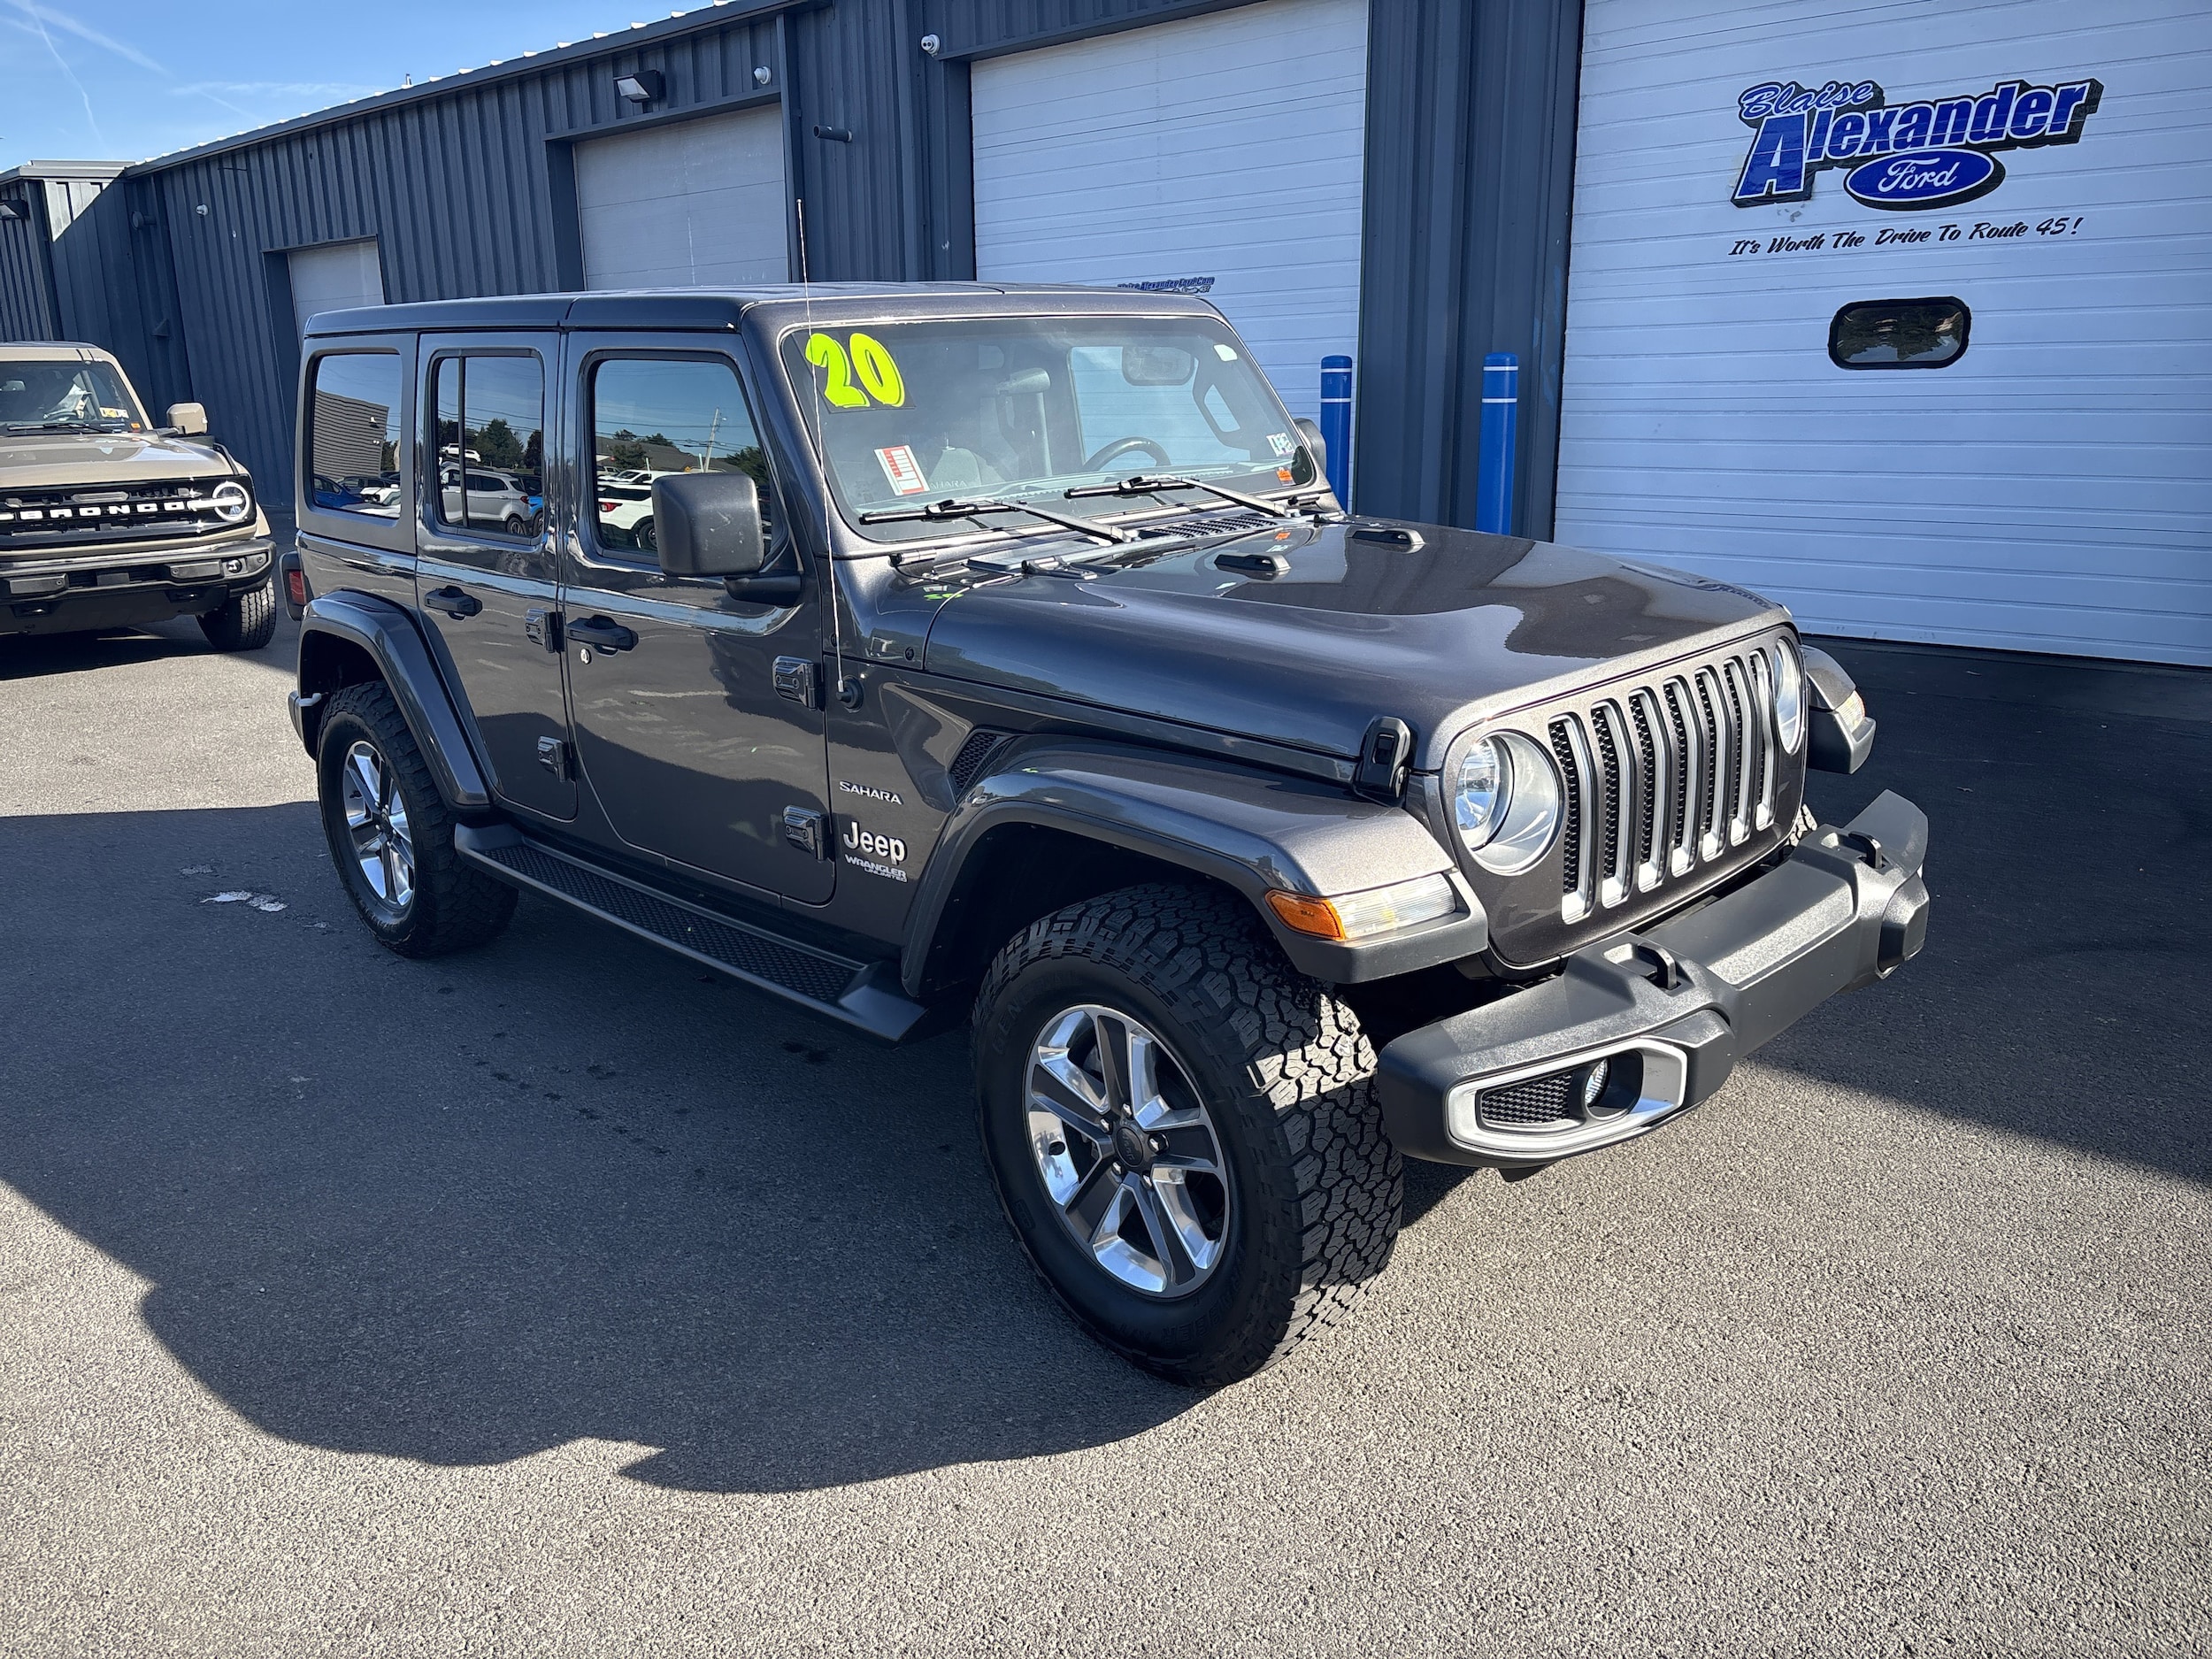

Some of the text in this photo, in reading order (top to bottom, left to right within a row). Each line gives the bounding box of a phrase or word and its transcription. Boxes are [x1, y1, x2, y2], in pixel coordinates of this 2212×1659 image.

[1740, 81, 1875, 121] Blaise
[1732, 80, 2092, 201] Alexander
[1877, 157, 1962, 193] Ford
[1728, 240, 1761, 256] It's
[1767, 233, 1825, 254] Worth
[1832, 230, 1865, 250] The
[1874, 227, 1932, 246] Drive
[1938, 223, 1962, 242] To
[1968, 221, 2029, 241] Route
[805, 333, 905, 408] 20
[19, 501, 185, 520] BRONCO
[839, 780, 903, 805] SAHARA
[843, 821, 907, 864] Jeep
[845, 854, 907, 878] WRANGLER
[864, 866, 908, 883] UNLIMITED
